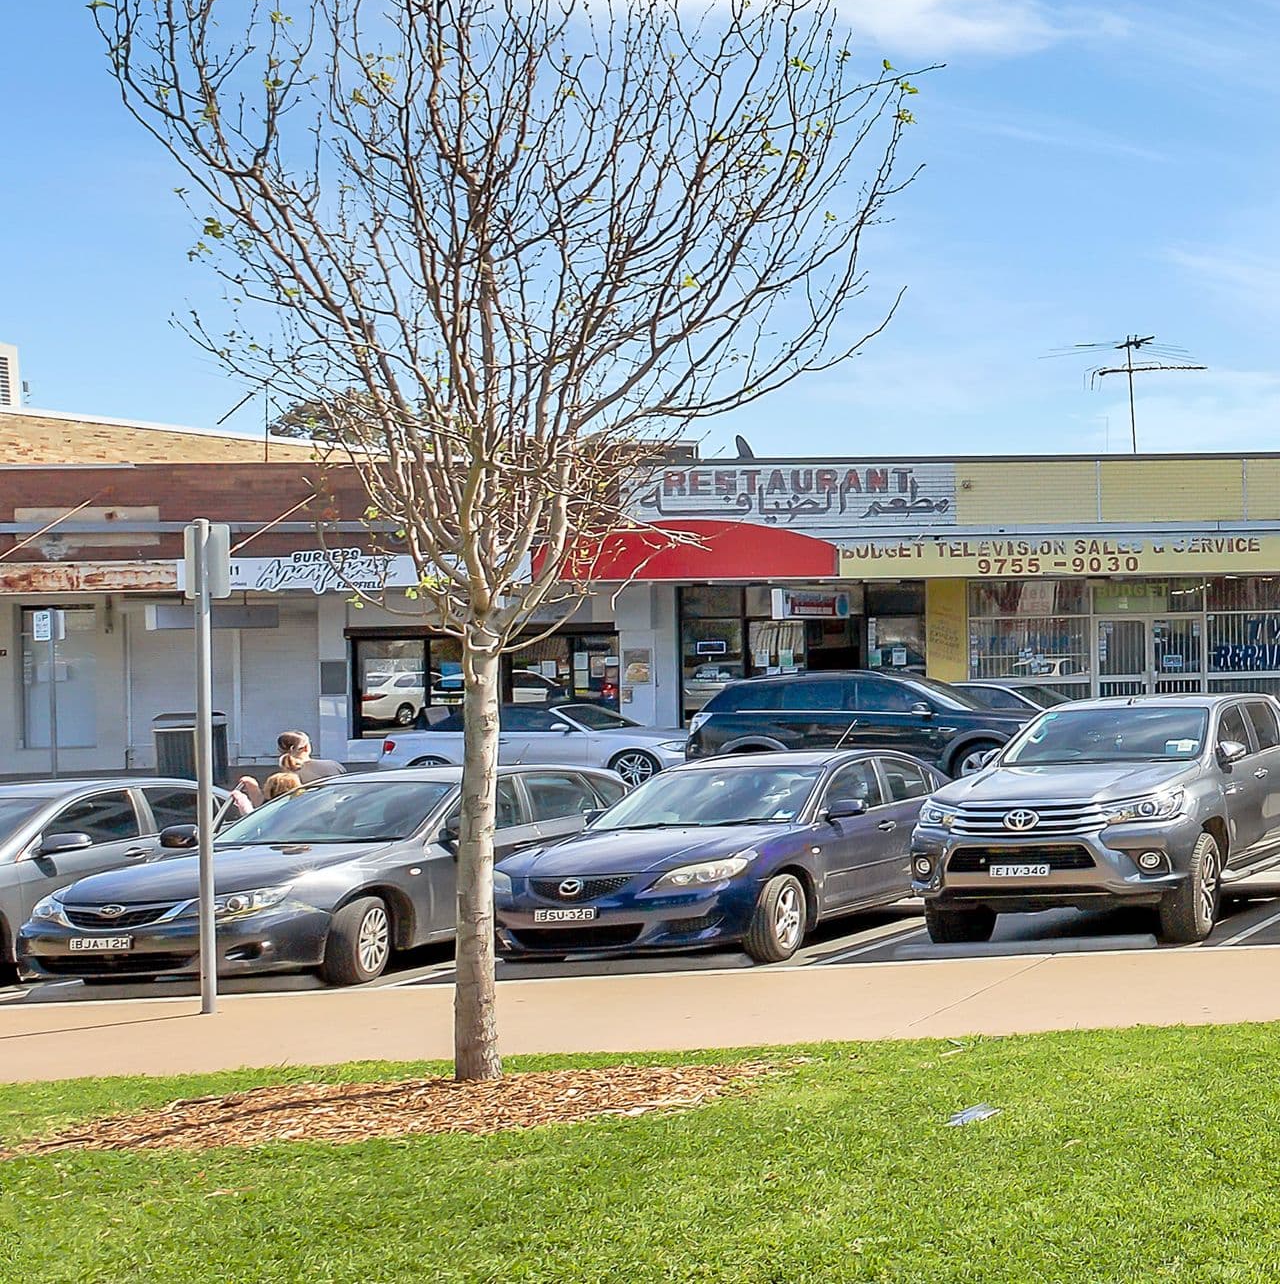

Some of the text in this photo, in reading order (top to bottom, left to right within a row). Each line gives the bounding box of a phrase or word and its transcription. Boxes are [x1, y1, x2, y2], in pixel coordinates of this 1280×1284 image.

[663, 468, 914, 495] RESTAURANT
[841, 542, 925, 559] BUDGET
[936, 539, 1067, 557] TELEVISION
[1172, 538, 1260, 554] SERVICE
[977, 558, 1041, 574] 9755
